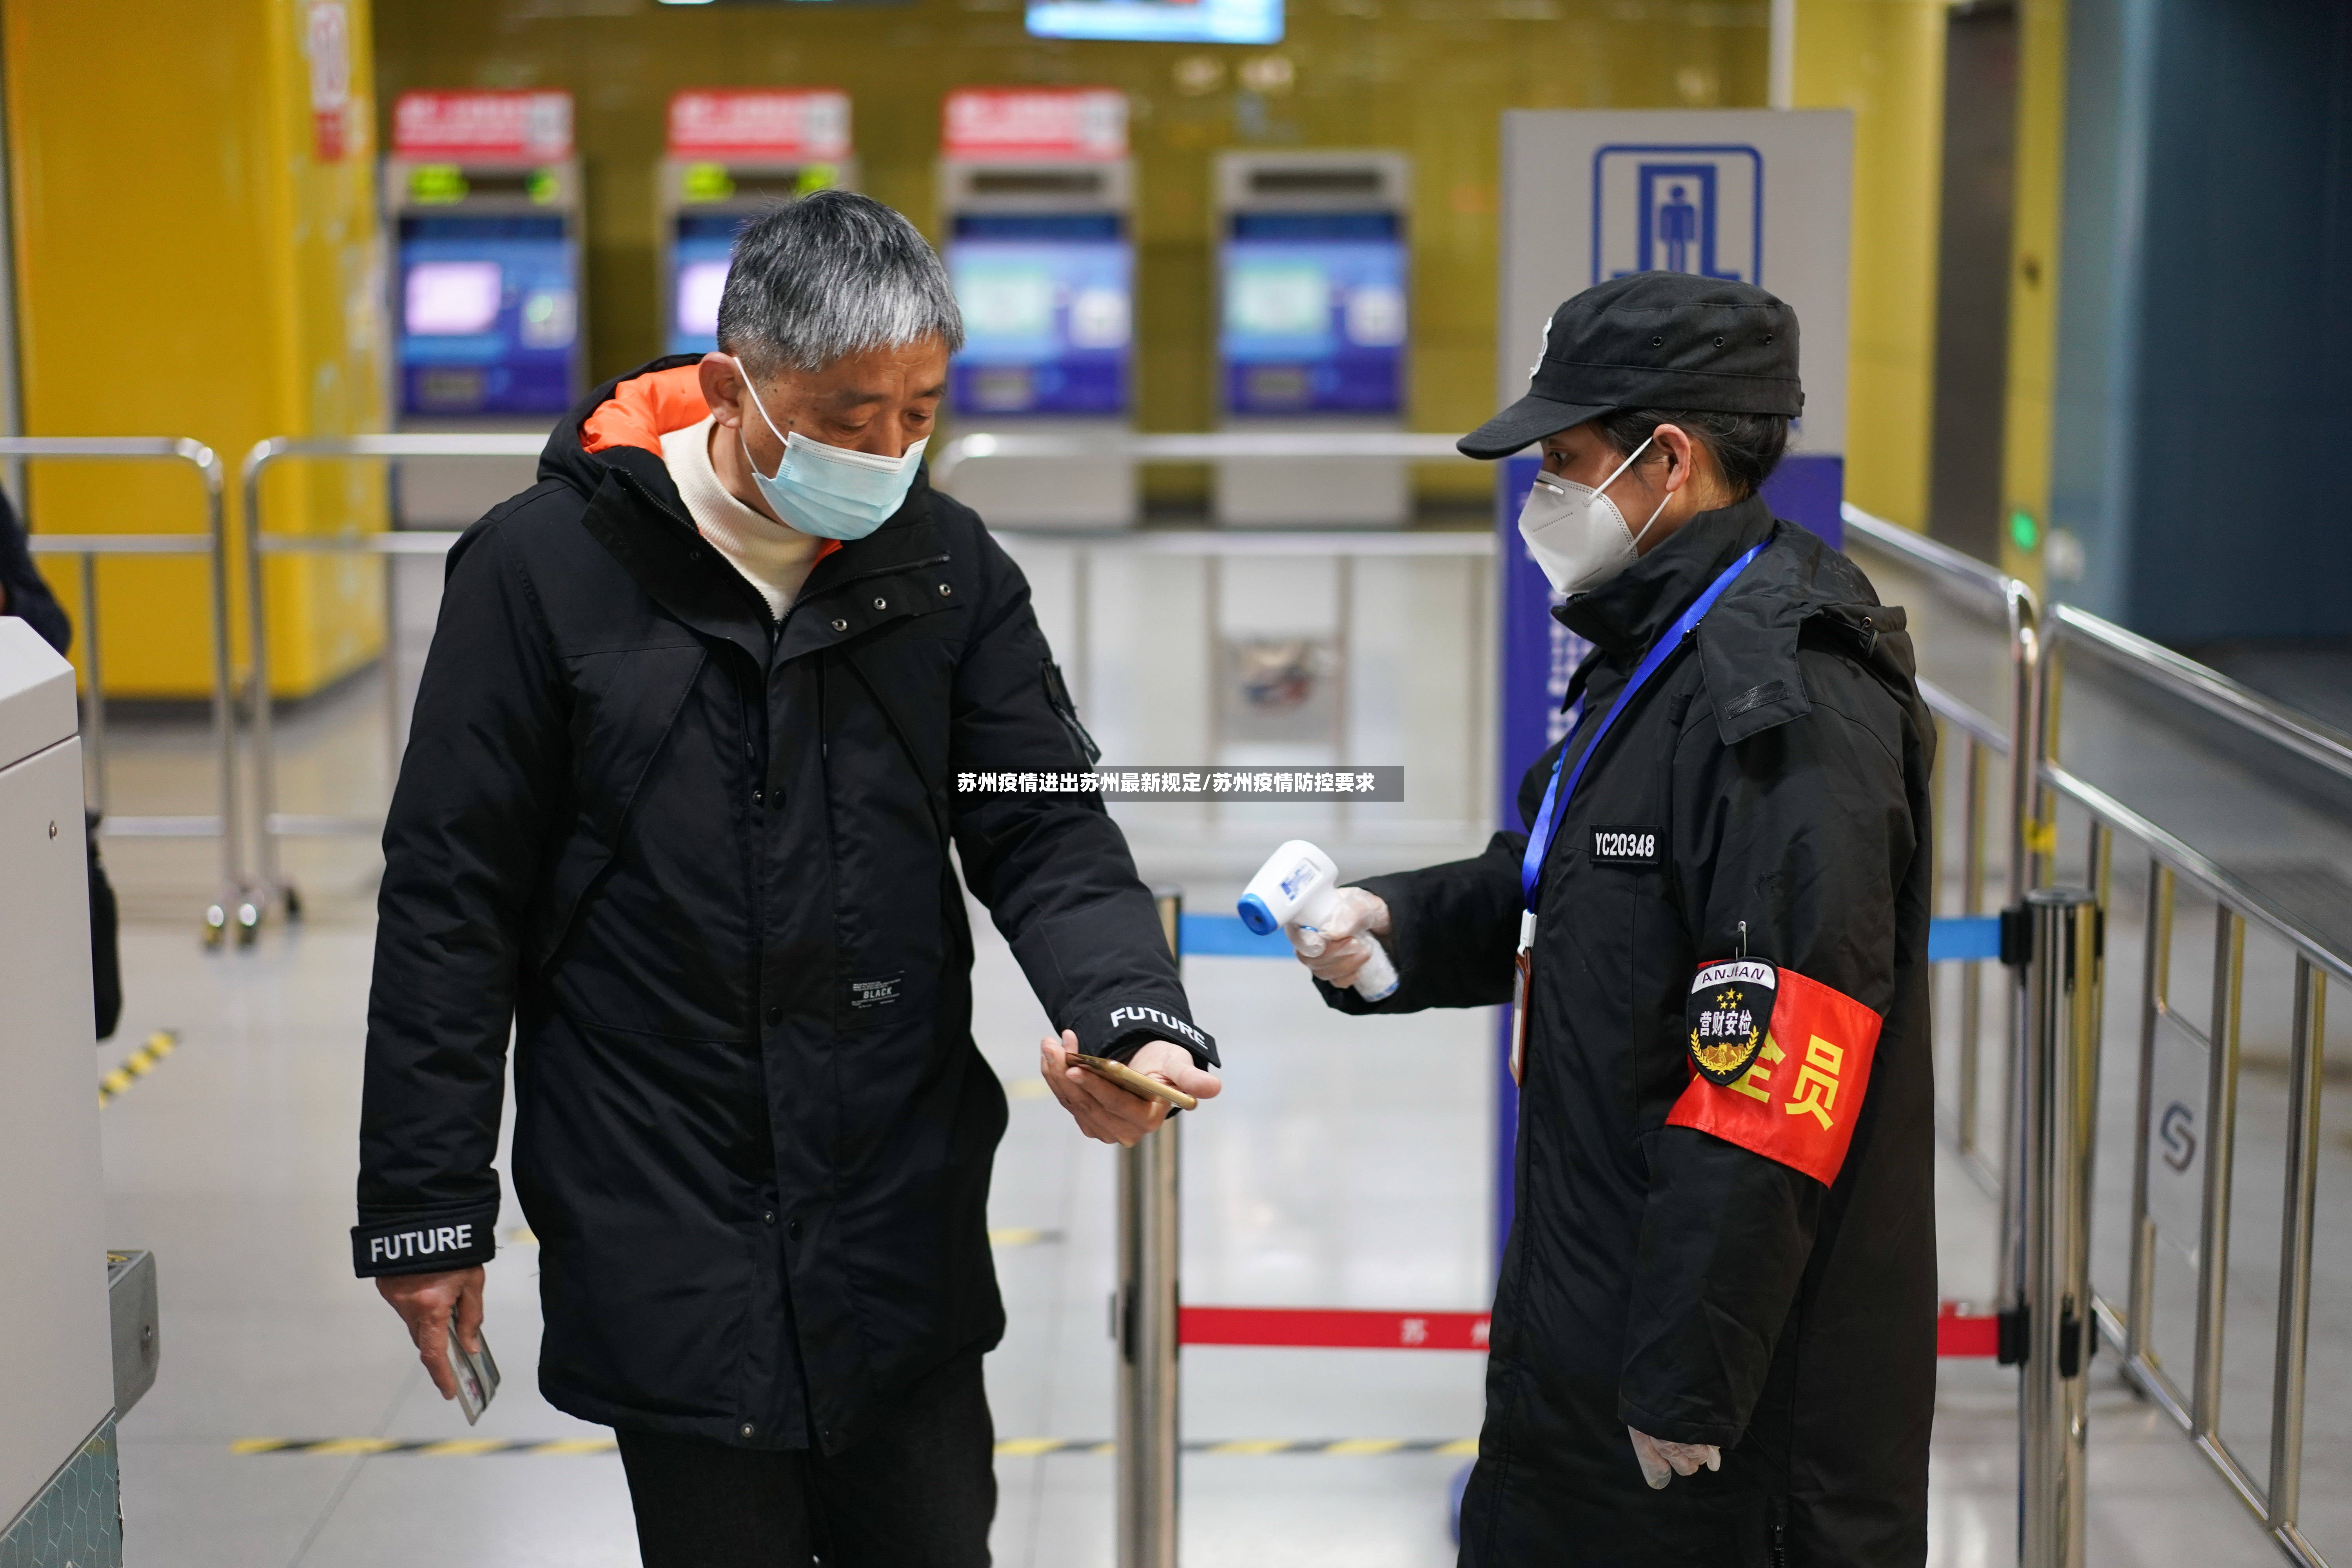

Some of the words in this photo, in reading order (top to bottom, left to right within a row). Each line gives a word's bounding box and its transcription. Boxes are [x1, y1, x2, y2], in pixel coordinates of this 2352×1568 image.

[1595, 833, 1655, 857] YC20348
[1701, 966, 1765, 984] ANJIAN
[863, 987, 892, 999] BLACK
[1111, 1006, 1209, 1050] FUTURE
[1700, 1009, 1752, 1037] 营财安检
[371, 1224, 472, 1263] FUTURE
